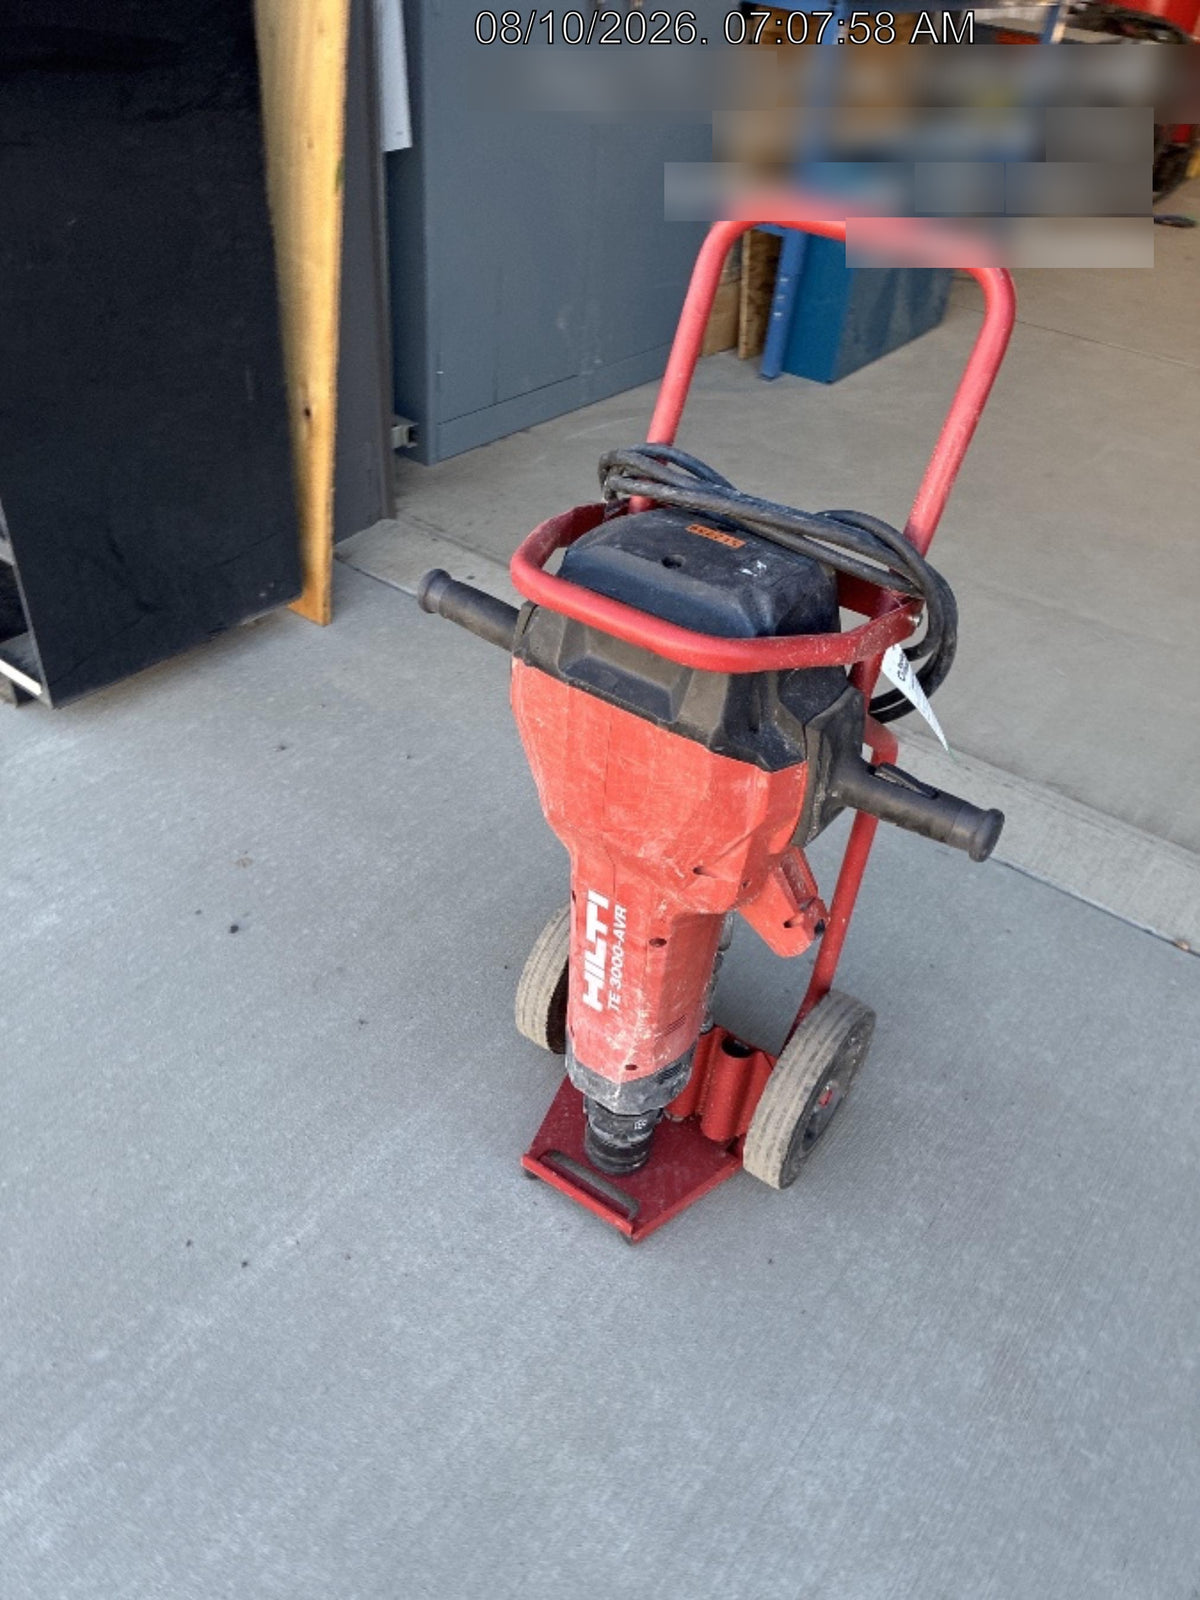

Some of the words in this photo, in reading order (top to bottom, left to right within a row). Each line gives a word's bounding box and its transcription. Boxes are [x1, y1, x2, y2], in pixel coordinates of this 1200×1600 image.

[583, 889, 609, 1012] HILTI
[609, 903, 627, 990] 3000-AVR
[607, 990, 621, 1012] TE
